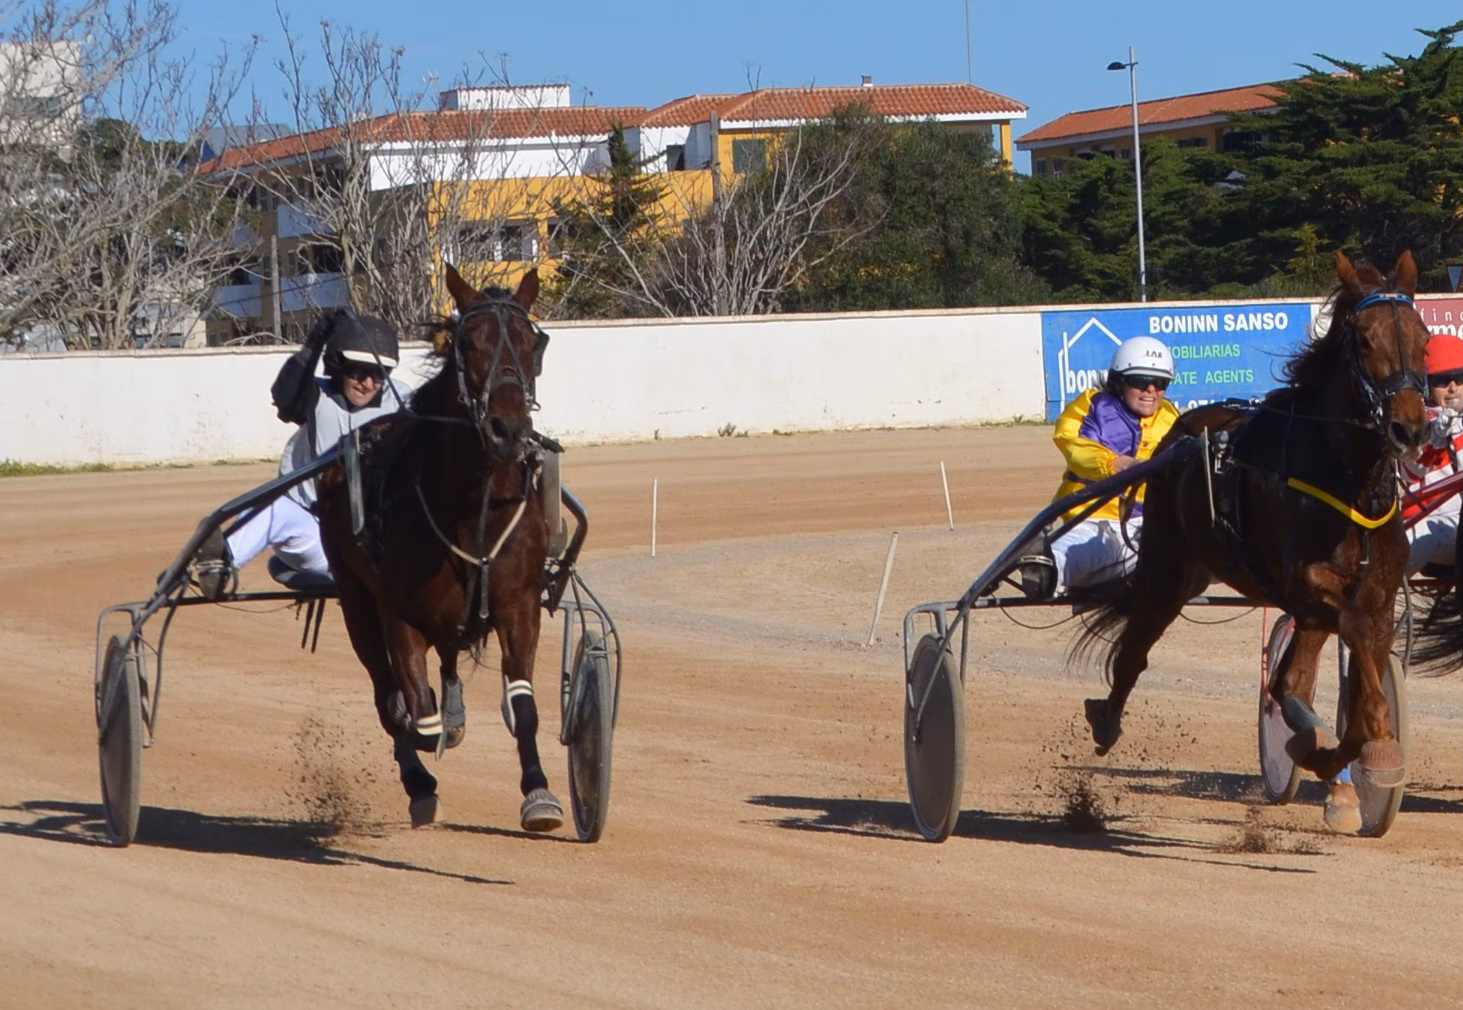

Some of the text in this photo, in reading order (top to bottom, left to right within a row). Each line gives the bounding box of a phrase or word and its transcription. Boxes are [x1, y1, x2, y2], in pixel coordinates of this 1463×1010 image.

[1149, 312, 1288, 334] BONINN SANSO
[1168, 343, 1241, 359] OBILIARIAS
[1204, 369, 1254, 385] AGENTS
